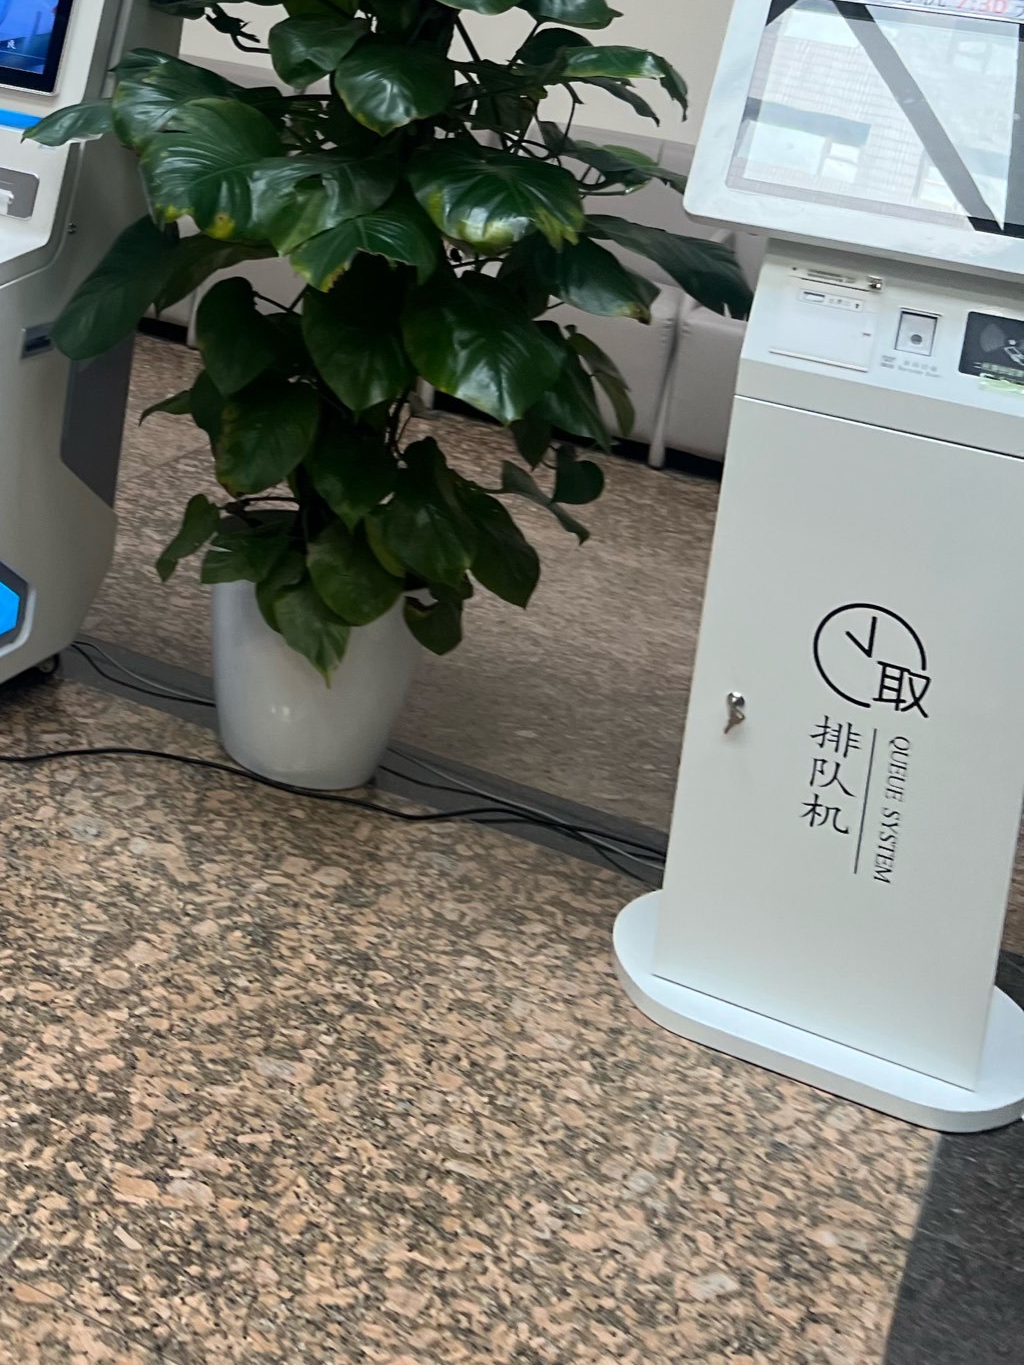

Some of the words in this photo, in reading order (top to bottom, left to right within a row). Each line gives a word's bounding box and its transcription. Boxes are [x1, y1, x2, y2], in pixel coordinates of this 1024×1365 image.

[872, 660, 932, 718] 取
[799, 714, 864, 836] 排队机
[884, 735, 911, 803] QUEUE
[873, 807, 901, 885] SYSTEM
